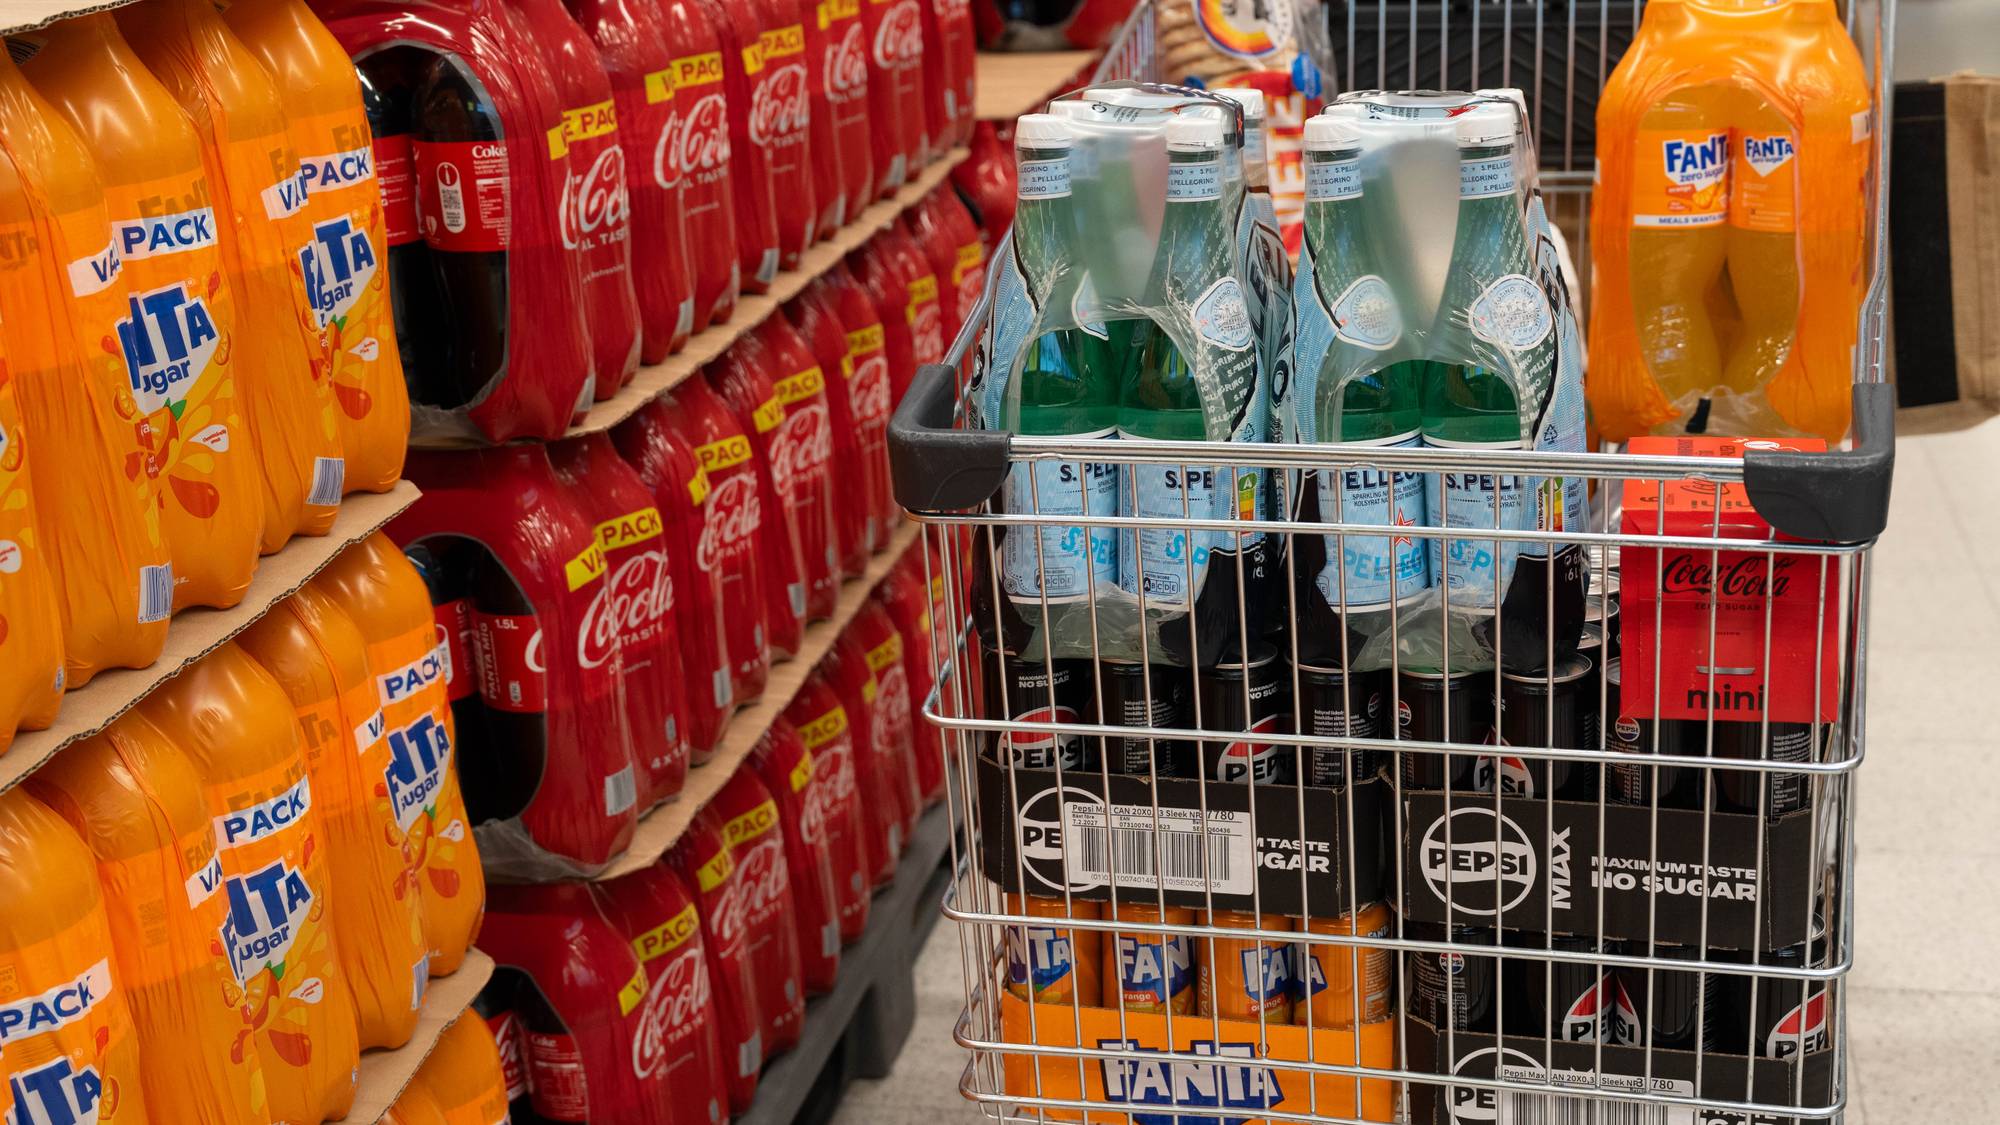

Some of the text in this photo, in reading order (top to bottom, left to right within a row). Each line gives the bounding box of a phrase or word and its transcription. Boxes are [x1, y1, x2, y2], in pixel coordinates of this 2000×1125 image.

[472, 145, 507, 159] Coke
[1744, 138, 1794, 158] FANTA
[302, 152, 371, 188] PACK
[122, 214, 212, 254] PACK
[601, 513, 659, 545] PACK
[384, 653, 442, 698] PACK
[1018, 681, 1035, 689] NO
[1687, 683, 1766, 713] mini
[224, 788, 305, 844] PACK
[1072, 804, 1094, 814] Pepsi
[1113, 806, 1131, 815] CAN
[1166, 809, 1188, 818] Sleek
[1265, 838, 1330, 853] TASTE
[1427, 847, 1528, 876] PEPSI
[1552, 826, 1572, 910] MAX
[1591, 855, 1758, 881] MAXIMUM TASTE
[1591, 870, 1758, 902] NO SUGAR
[0, 976, 94, 1039] PACK
[1503, 1068, 1527, 1079] Pepsi
[1528, 1071, 1545, 1080] Max
[1601, 1077, 1625, 1087] Sleek
